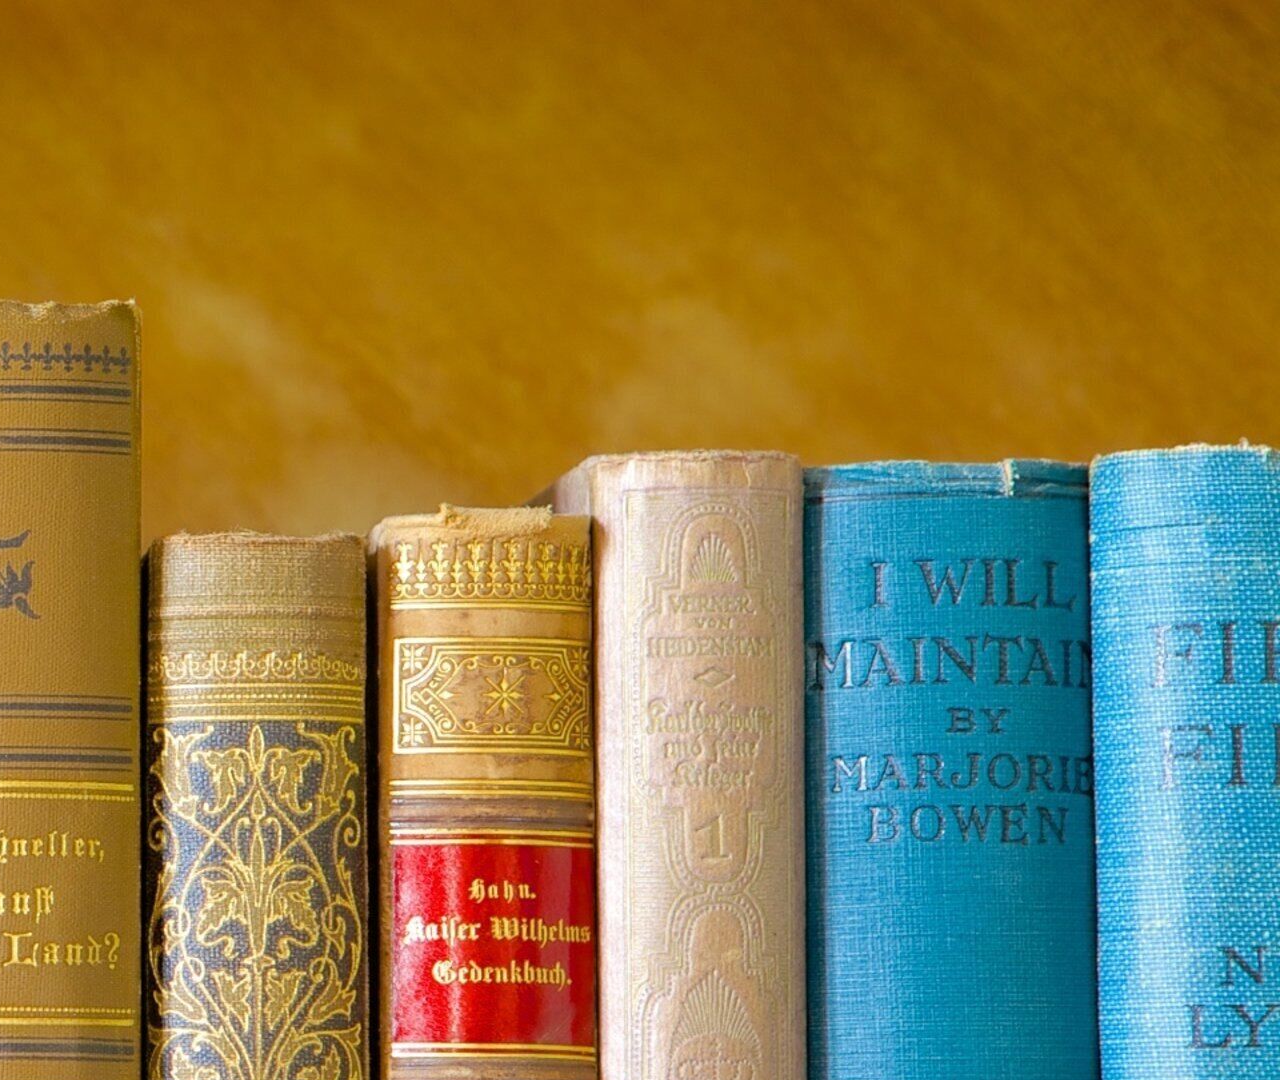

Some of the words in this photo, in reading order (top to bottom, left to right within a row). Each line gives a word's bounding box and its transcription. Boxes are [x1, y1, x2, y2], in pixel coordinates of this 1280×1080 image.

[869, 560, 890, 610] I
[913, 557, 1078, 612] WILL
[946, 706, 1011, 734] BY
[865, 803, 1069, 845] BOWEN
[469, 878, 537, 904] Hahn.
[489, 915, 592, 949] Wilhelms
[2, 932, 121, 970] Land?
[432, 959, 573, 992] Gedenkbuch.
